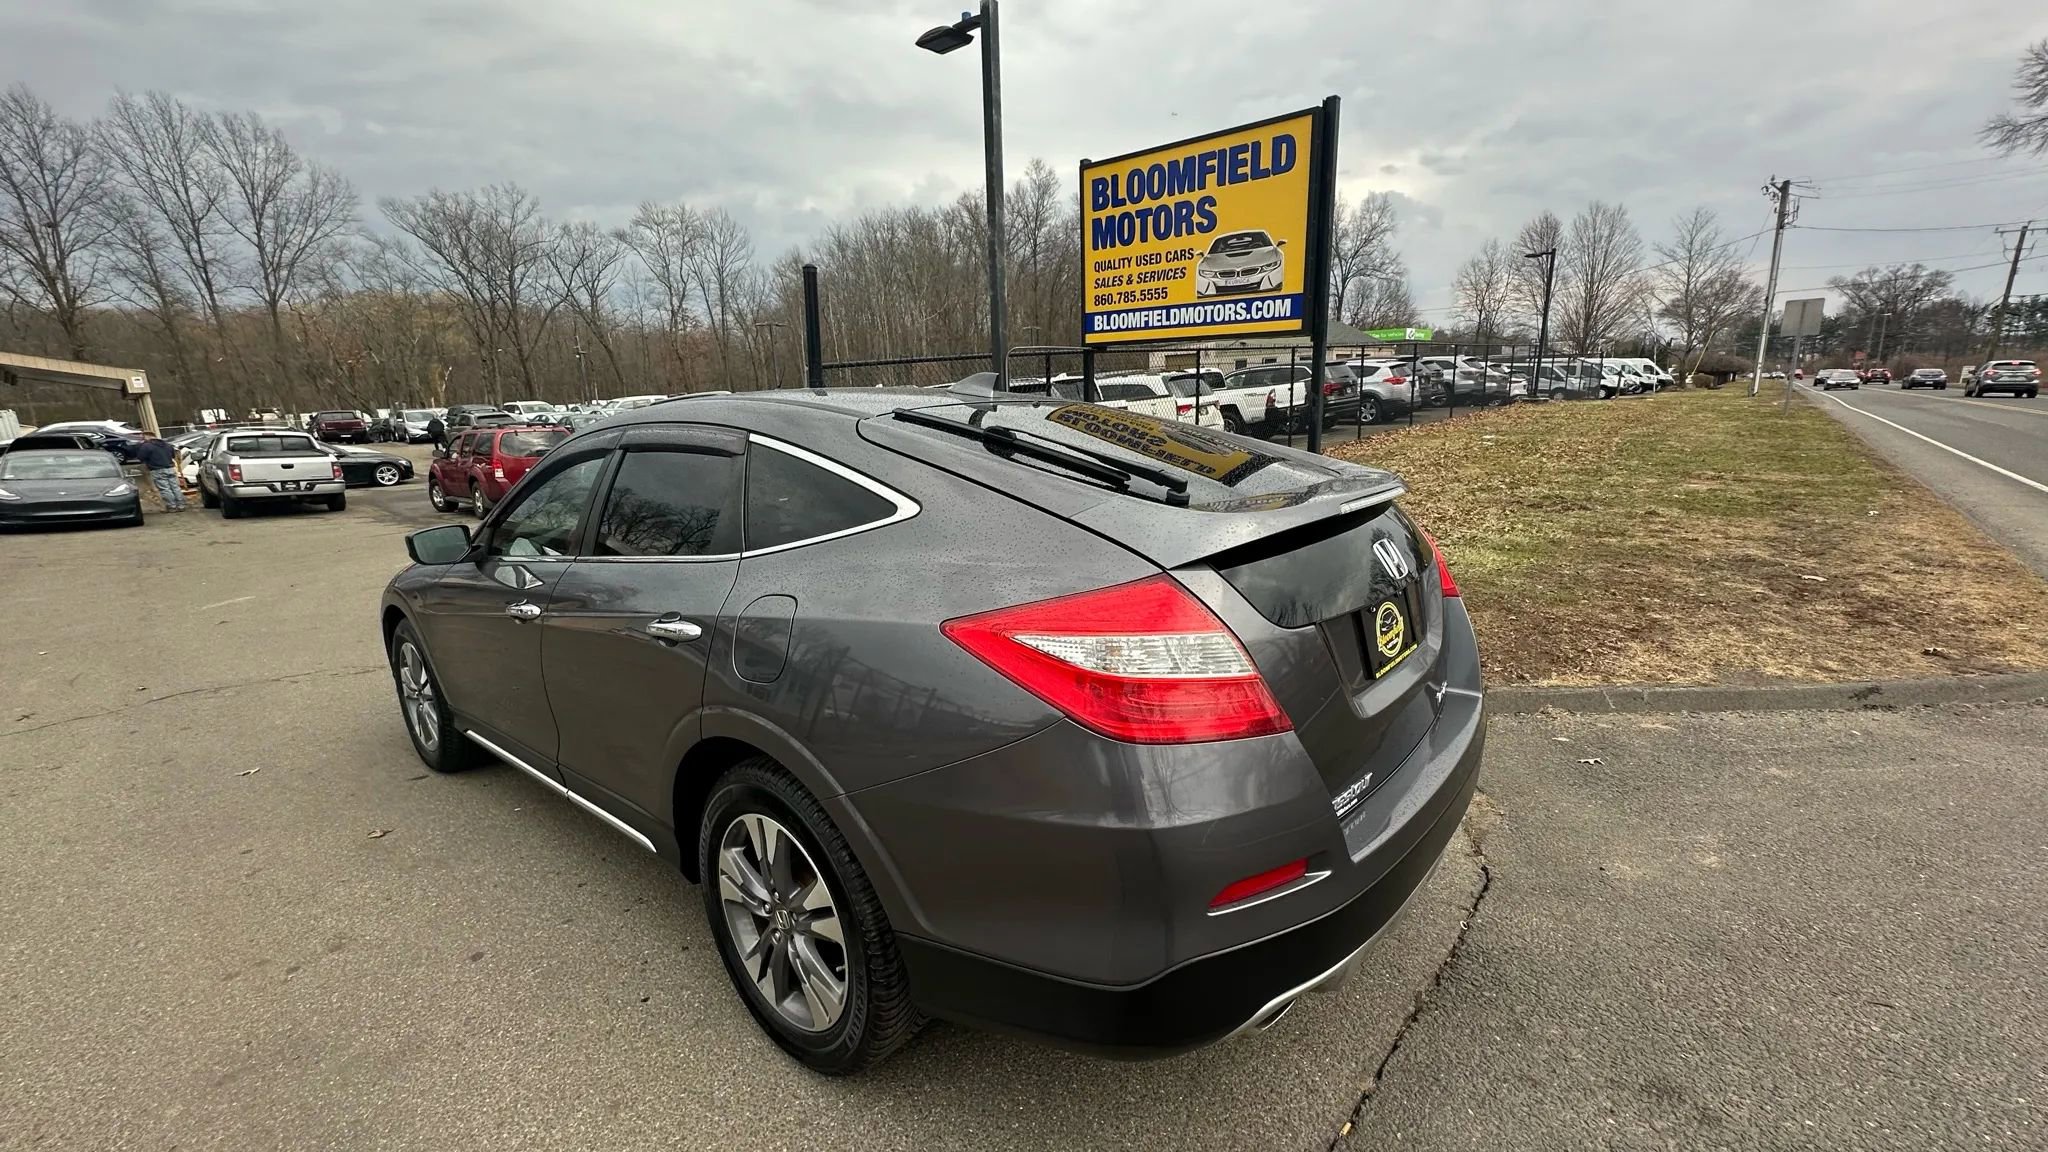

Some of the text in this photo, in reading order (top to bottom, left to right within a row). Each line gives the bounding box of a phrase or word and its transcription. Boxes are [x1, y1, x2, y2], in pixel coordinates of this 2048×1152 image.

[1091, 134, 1296, 212] BLOOMFIELD
[1091, 195, 1217, 251] MOTORS
[1094, 247, 1194, 273] QUALITY USED CARS
[1094, 268, 1187, 289] SALES & SERVICES
[1094, 287, 1168, 307] 860.785.5555
[1094, 299, 1291, 331] BLOOMFIELDMOTORS.COM
